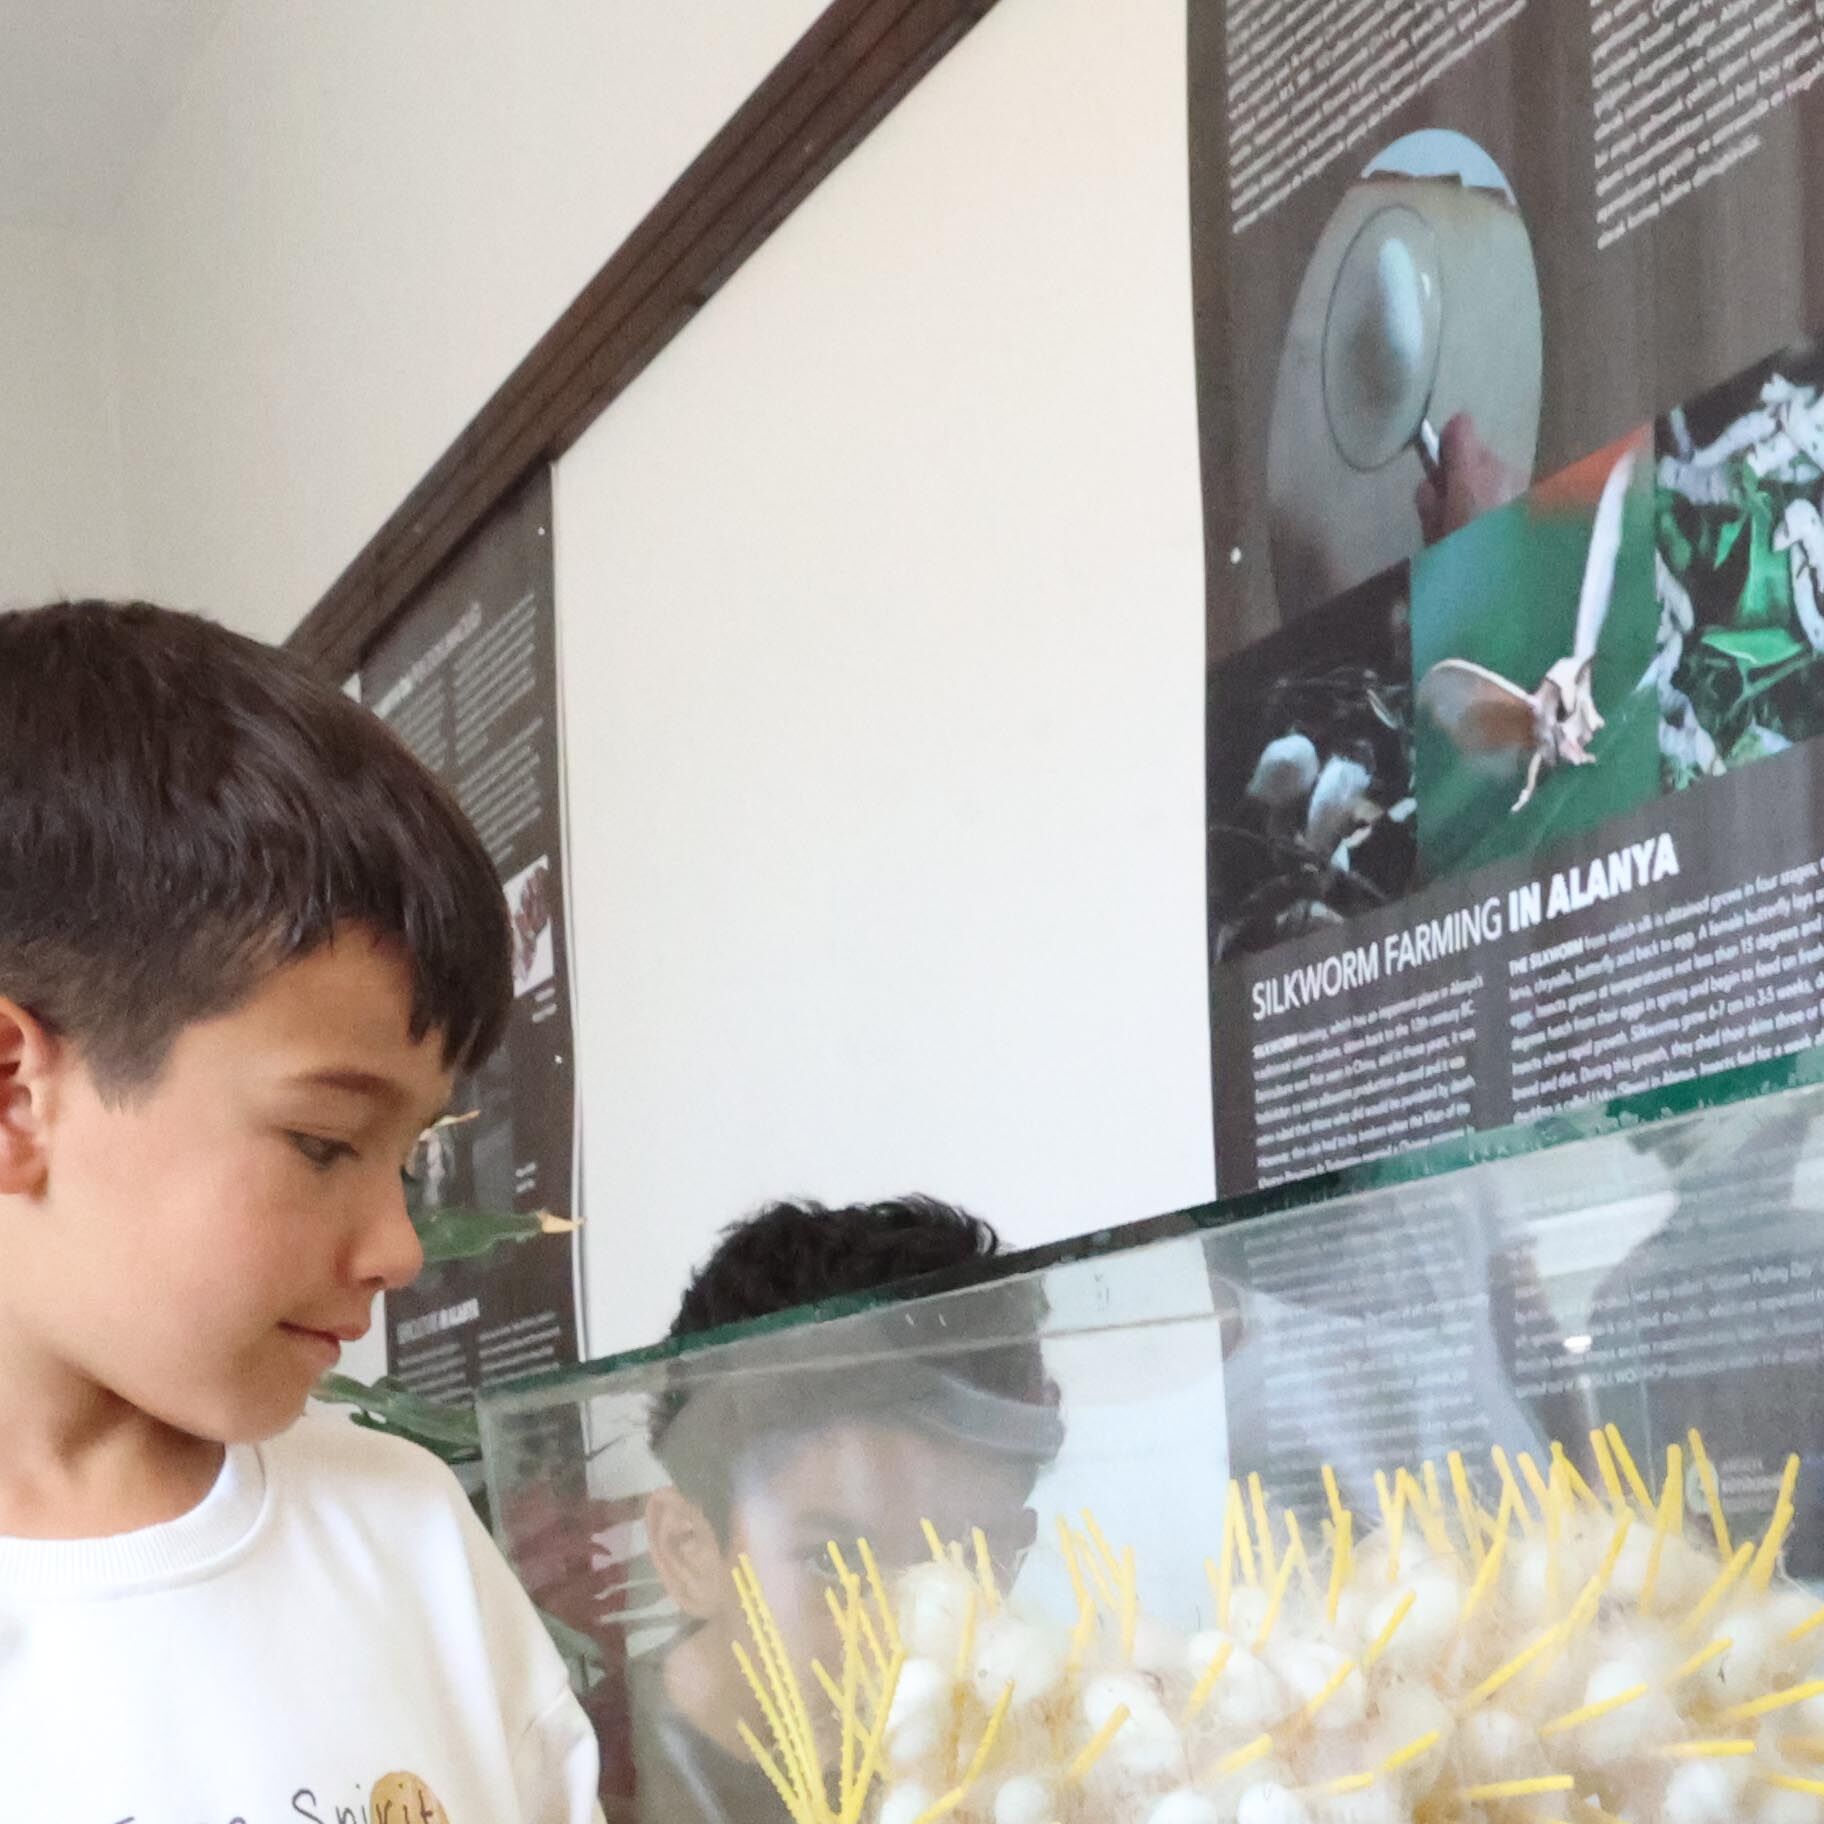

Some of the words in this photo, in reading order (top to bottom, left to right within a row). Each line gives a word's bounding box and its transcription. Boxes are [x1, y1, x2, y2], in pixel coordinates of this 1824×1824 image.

[1252, 942, 1378, 1021] SILKWORM
[1384, 896, 1504, 975] FARMING
[1508, 882, 1541, 933] IN
[1547, 832, 1680, 920] ALANYA
